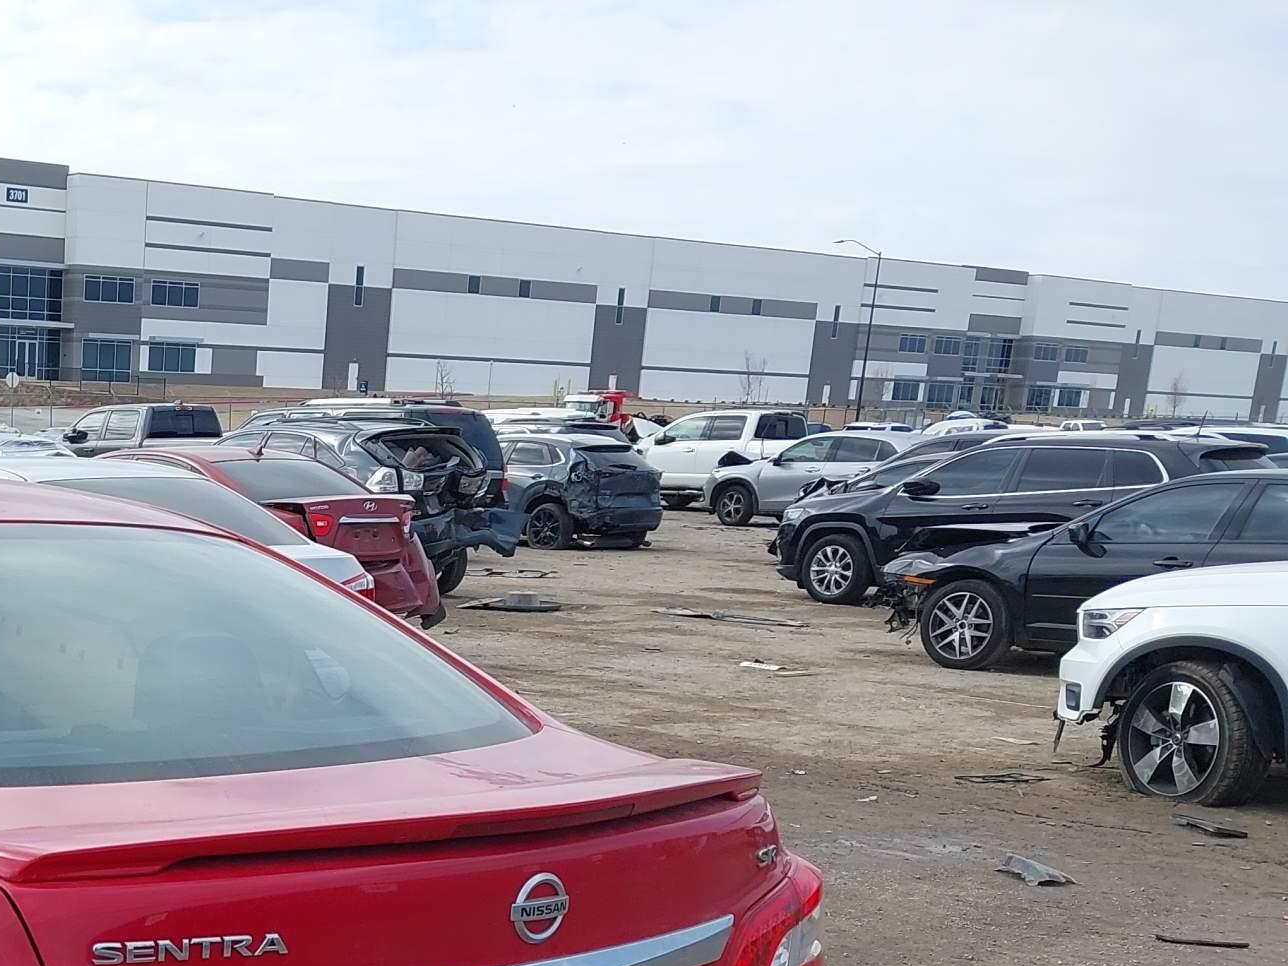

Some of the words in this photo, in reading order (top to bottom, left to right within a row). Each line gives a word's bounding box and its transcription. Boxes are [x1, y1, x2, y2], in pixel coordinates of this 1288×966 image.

[8, 190, 26, 201] 3701
[521, 902, 567, 917] NISSAN
[92, 933, 289, 965] SENTRA
